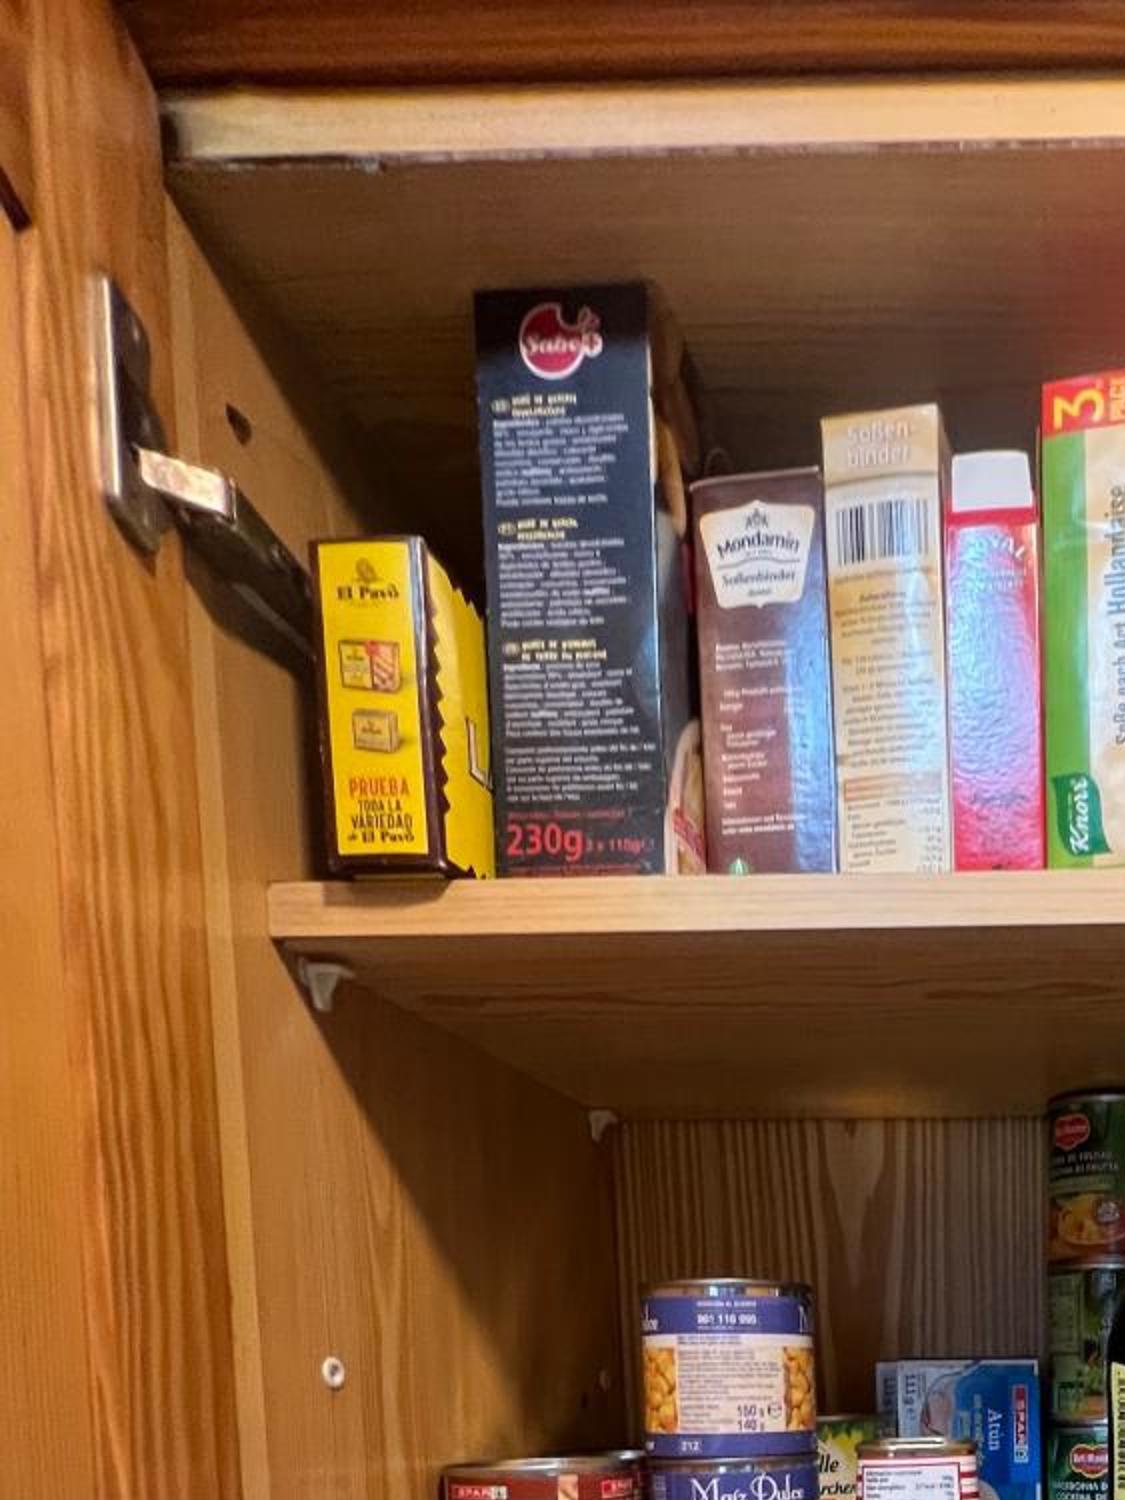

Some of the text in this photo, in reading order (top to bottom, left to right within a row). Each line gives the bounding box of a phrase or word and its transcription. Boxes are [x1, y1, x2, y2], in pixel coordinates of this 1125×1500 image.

[716, 530, 801, 559] Mondamin
[349, 777, 410, 797] PRUEBA
[350, 814, 414, 831] VARIEDAD
[1068, 777, 1089, 855] Knorr
[505, 822, 584, 862] 230g
[818, 1453, 840, 1474] lle
